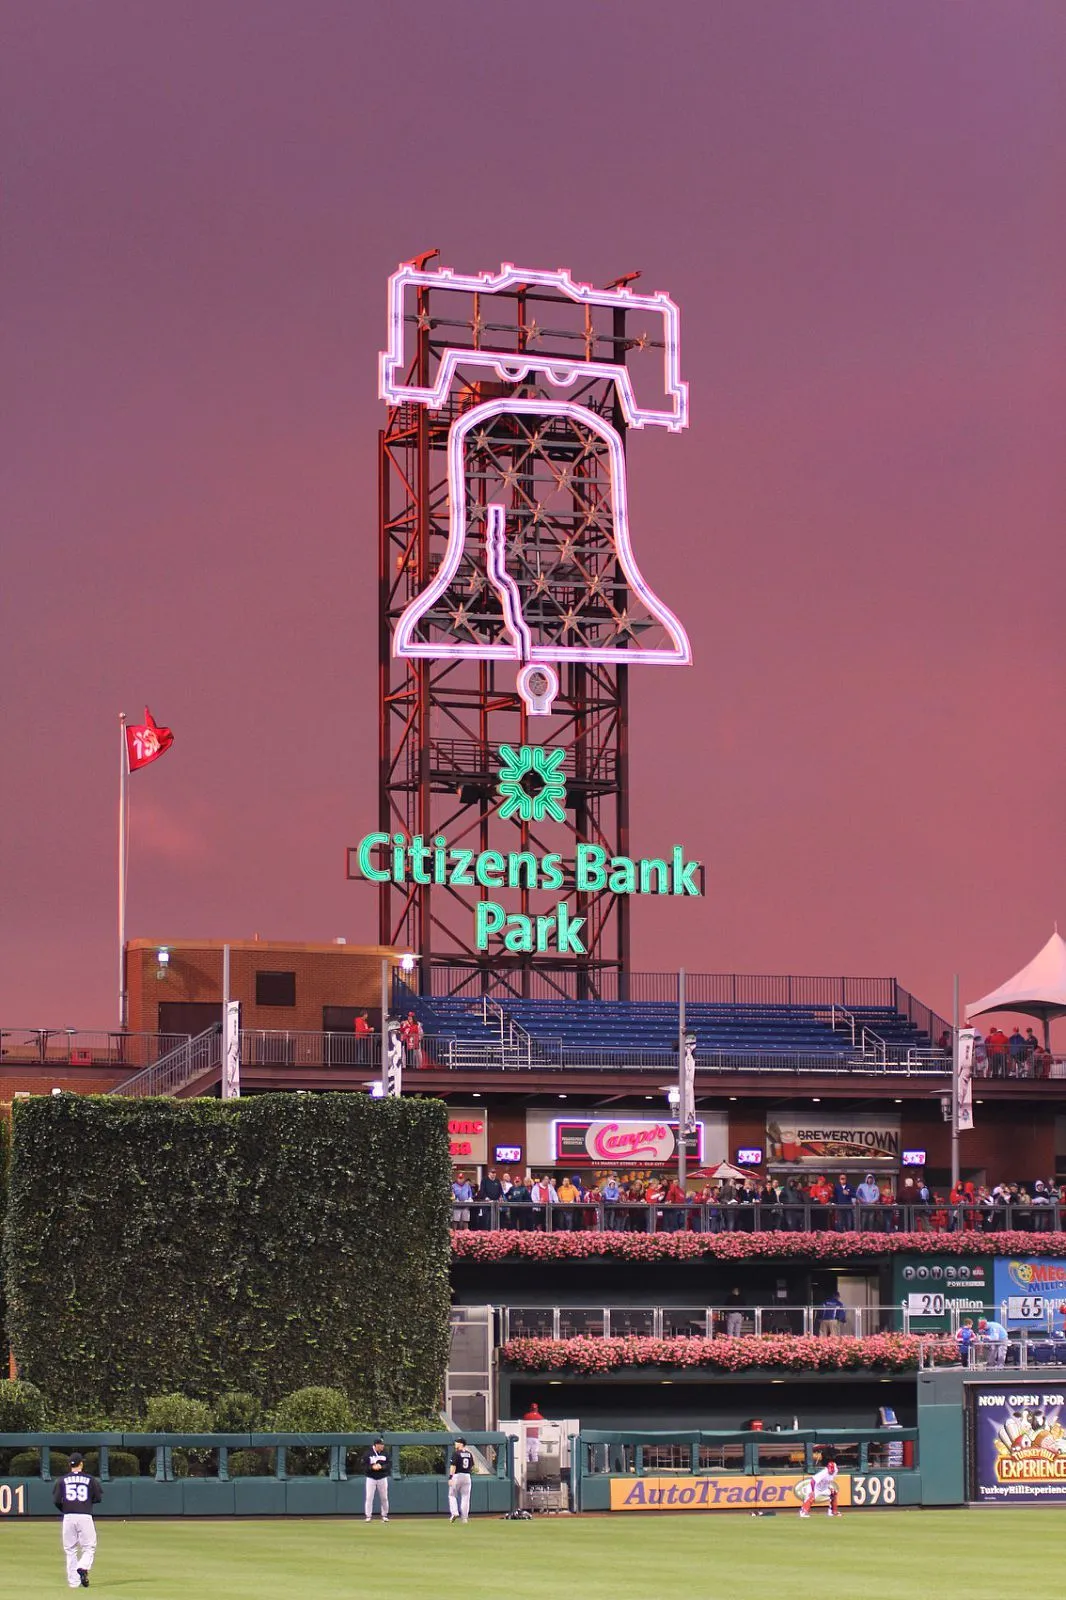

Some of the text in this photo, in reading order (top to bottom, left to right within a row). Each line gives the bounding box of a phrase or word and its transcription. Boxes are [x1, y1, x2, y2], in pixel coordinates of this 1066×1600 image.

[358, 832, 702, 896] Citizens Bank
[476, 901, 587, 955] Park
[594, 1123, 666, 1159] Campo's
[798, 1130, 898, 1154] BREWERYTOWN
[903, 1266, 970, 1280] POWER
[922, 1294, 943, 1314] 20
[945, 1299, 984, 1309] Million
[1021, 1298, 1041, 1317] 65
[978, 1395, 1064, 1407] NOW OPEN FOR
[463, 1458, 469, 1469] 9
[1012, 1449, 1039, 1461] TURKEY
[65, 1484, 88, 1502] 59
[622, 1480, 793, 1505] AutoTrader
[852, 1476, 896, 1506] 398
